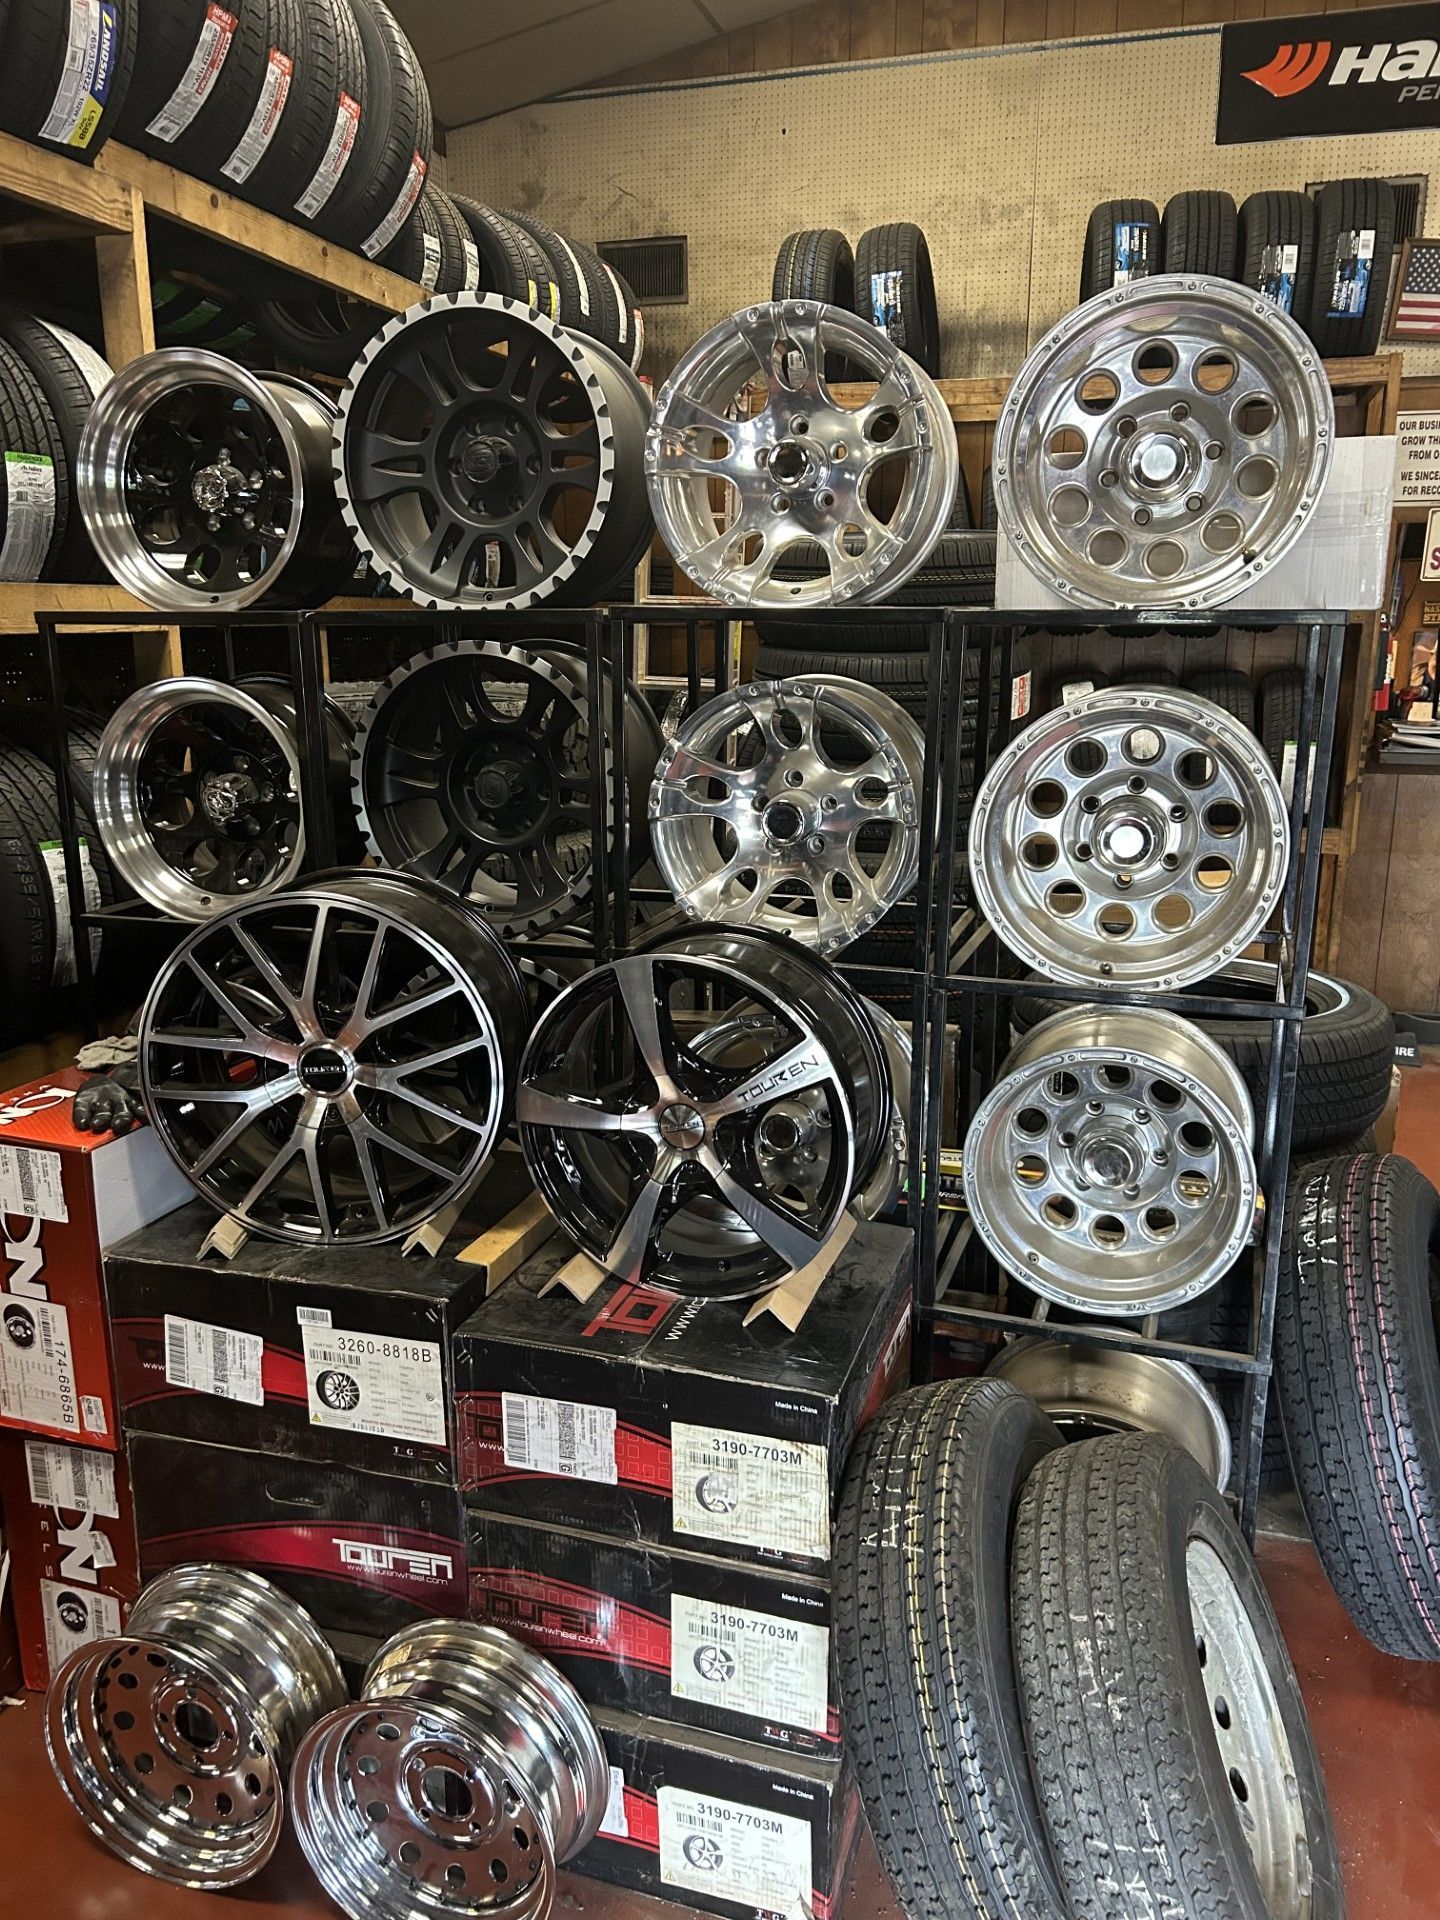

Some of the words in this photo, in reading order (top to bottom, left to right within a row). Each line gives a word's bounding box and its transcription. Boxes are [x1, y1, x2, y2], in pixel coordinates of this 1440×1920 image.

[1328, 40, 1440, 86] Ha
[1397, 84, 1440, 102] PE
[1400, 421, 1417, 431] OUR
[1401, 436, 1426, 446] GROW
[1409, 450, 1432, 460] FROM
[1400, 471, 1413, 481] WE
[1415, 471, 1440, 481] SINCE
[1402, 486, 1419, 496] FOR
[738, 1054, 820, 1102] TOUREN
[338, 1336, 432, 1363] 3260-8818B
[54, 1340, 75, 1424] 174-6865B
[775, 1401, 792, 1410] Made
[800, 1405, 818, 1414] China
[712, 1438, 802, 1465] 3190-7703M
[39, 1503, 54, 1578] EELS
[332, 1537, 454, 1580] TOUREN
[781, 1593, 799, 1602] Made
[806, 1599, 824, 1608] China
[711, 1611, 799, 1642] 3190-7703M
[772, 1783, 789, 1793] Made
[796, 1790, 815, 1800] China
[697, 1802, 783, 1835] 3190-7703M
